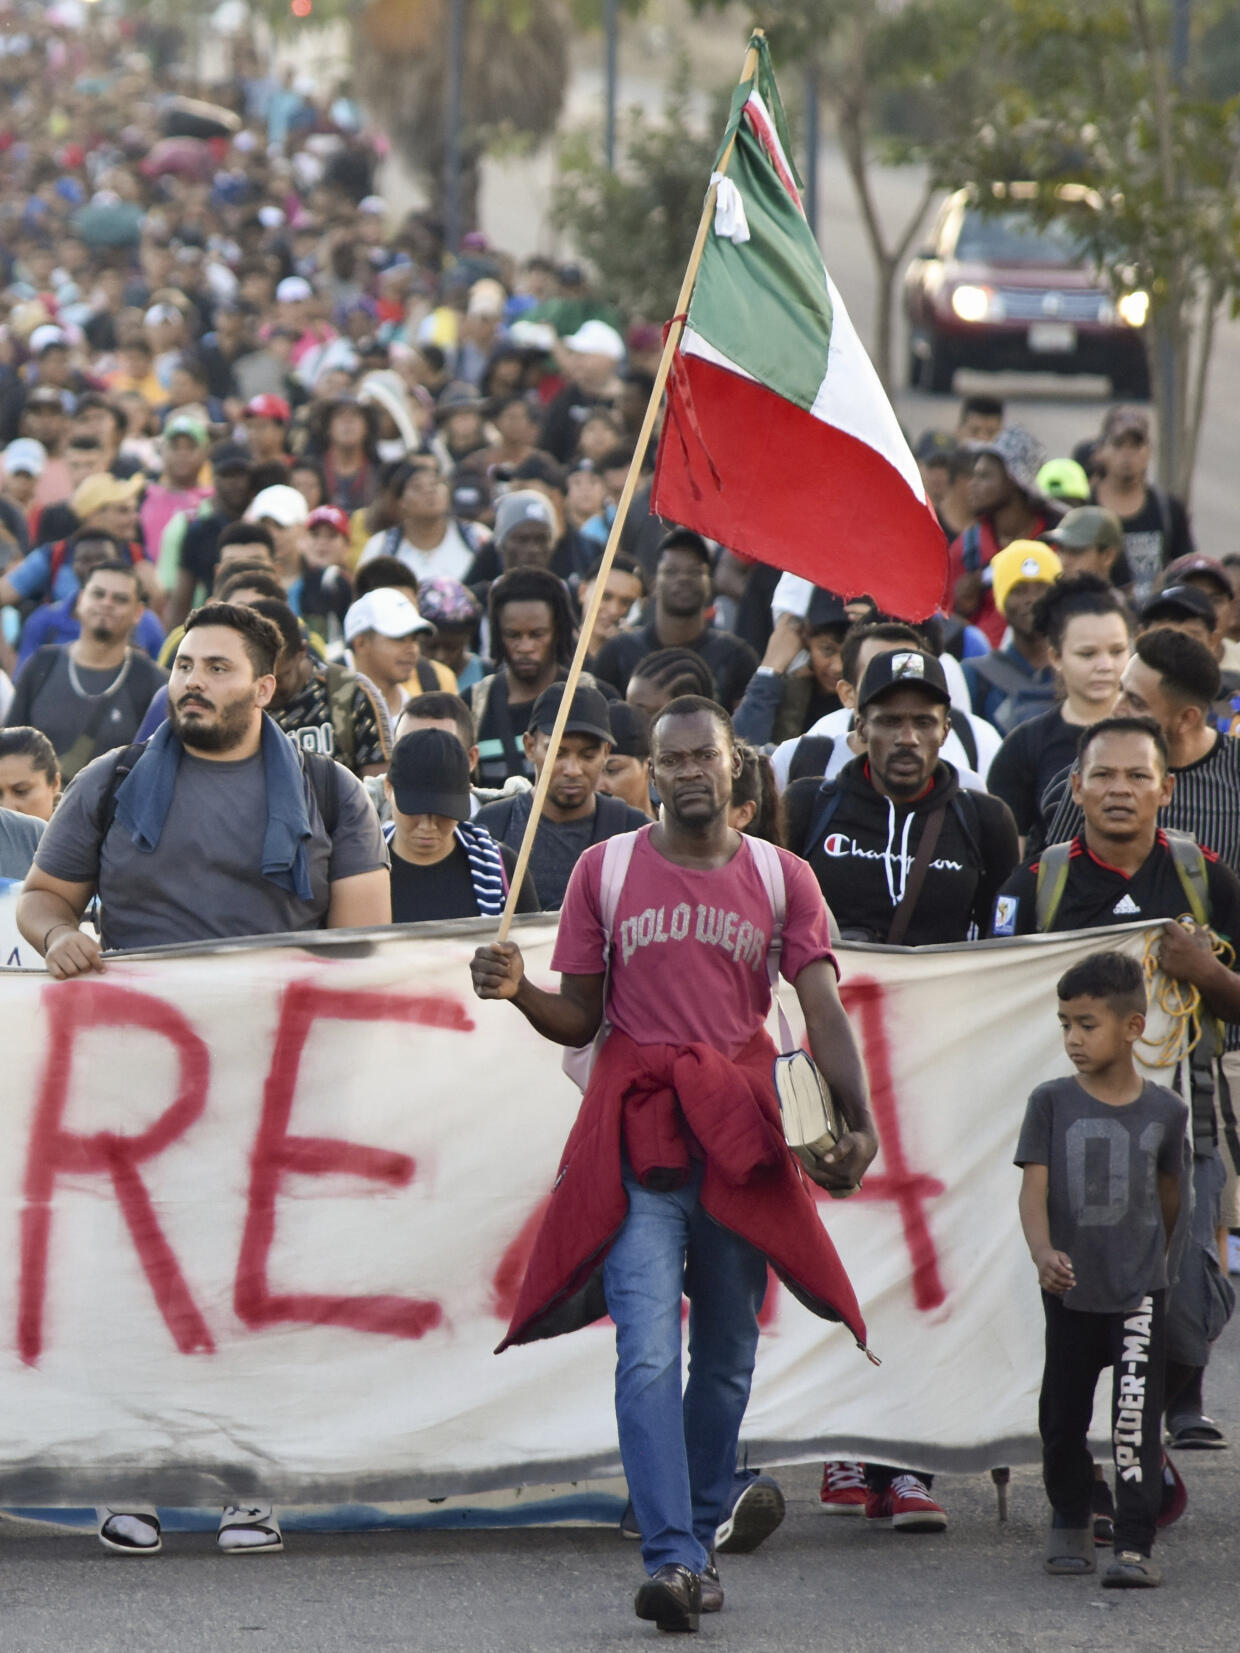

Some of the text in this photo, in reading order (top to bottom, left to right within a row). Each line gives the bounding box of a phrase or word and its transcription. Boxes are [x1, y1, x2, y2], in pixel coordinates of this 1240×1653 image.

[824, 833, 963, 875] Champon
[620, 902, 765, 972] POLO WEAR
